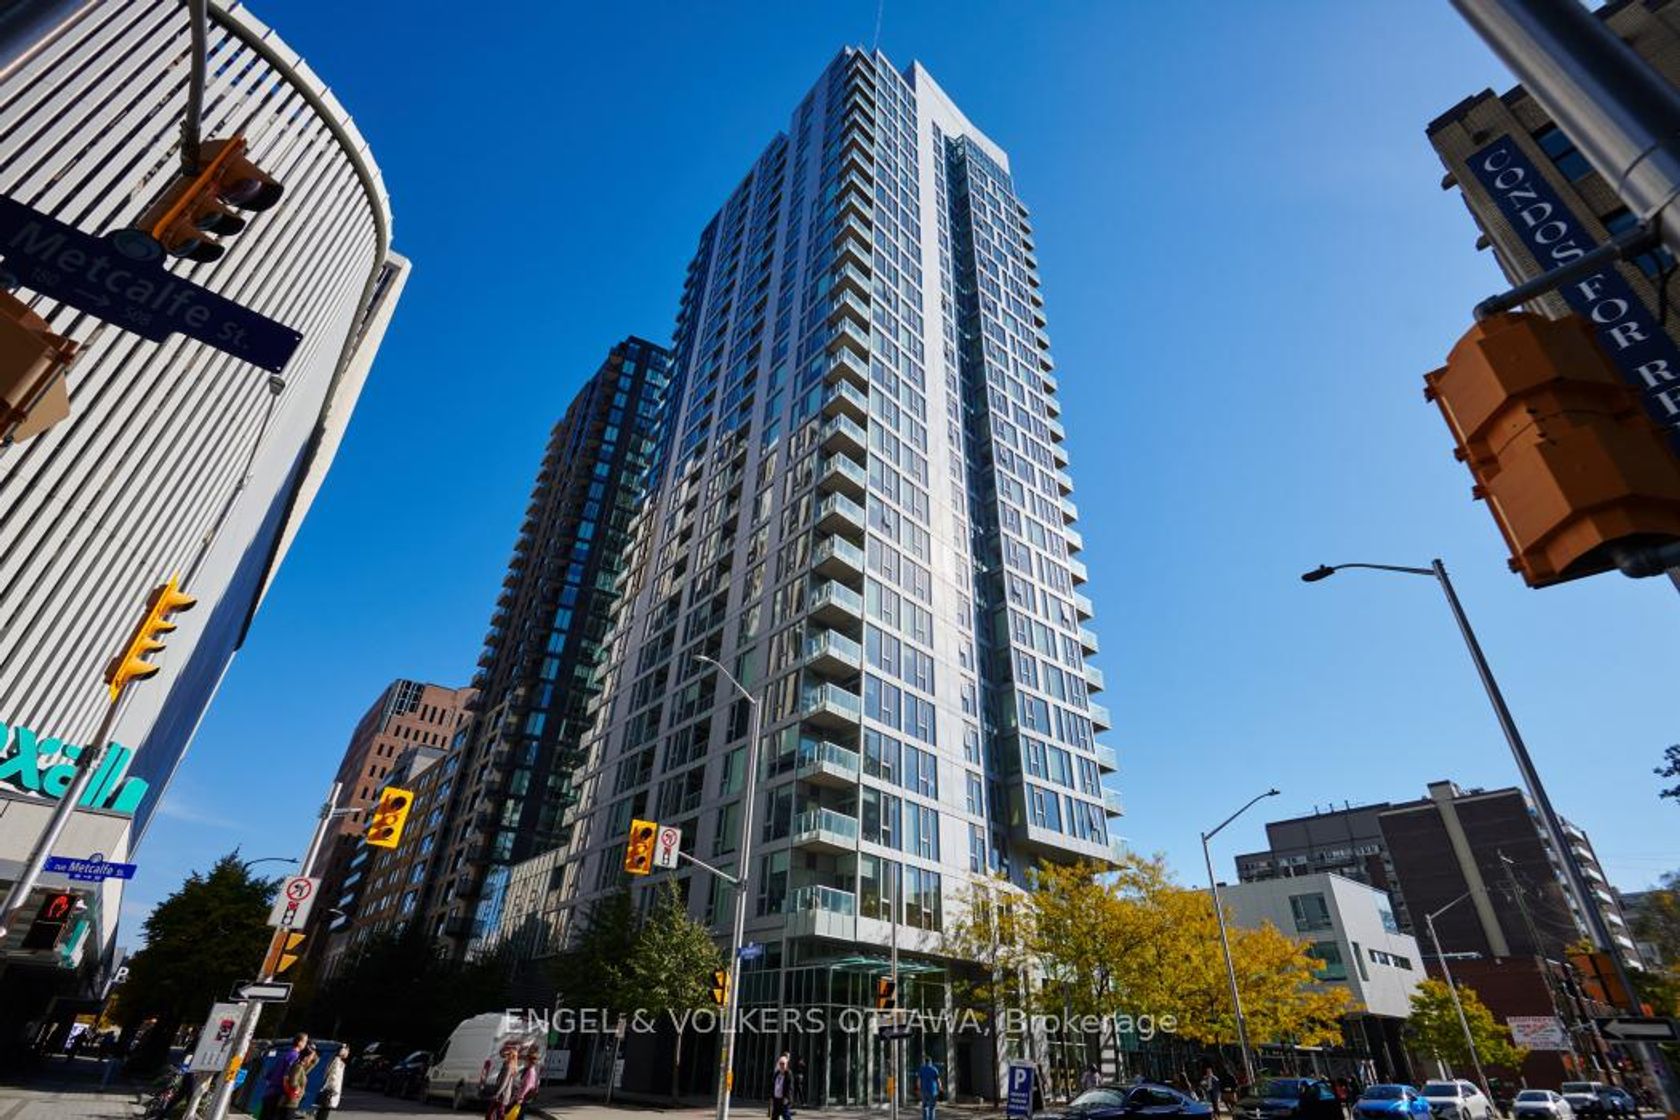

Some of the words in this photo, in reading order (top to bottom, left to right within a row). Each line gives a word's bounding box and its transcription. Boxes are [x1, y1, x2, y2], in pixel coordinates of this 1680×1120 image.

[8, 221, 211, 328] Metcalfe
[217, 321, 250, 350] St.
[1484, 149, 1584, 267] CONDOS
[1576, 274, 1649, 350] FOR
[1633, 359, 1680, 426] RE
[68, 861, 114, 875] Metcalfe
[1014, 1068, 1027, 1090] P
